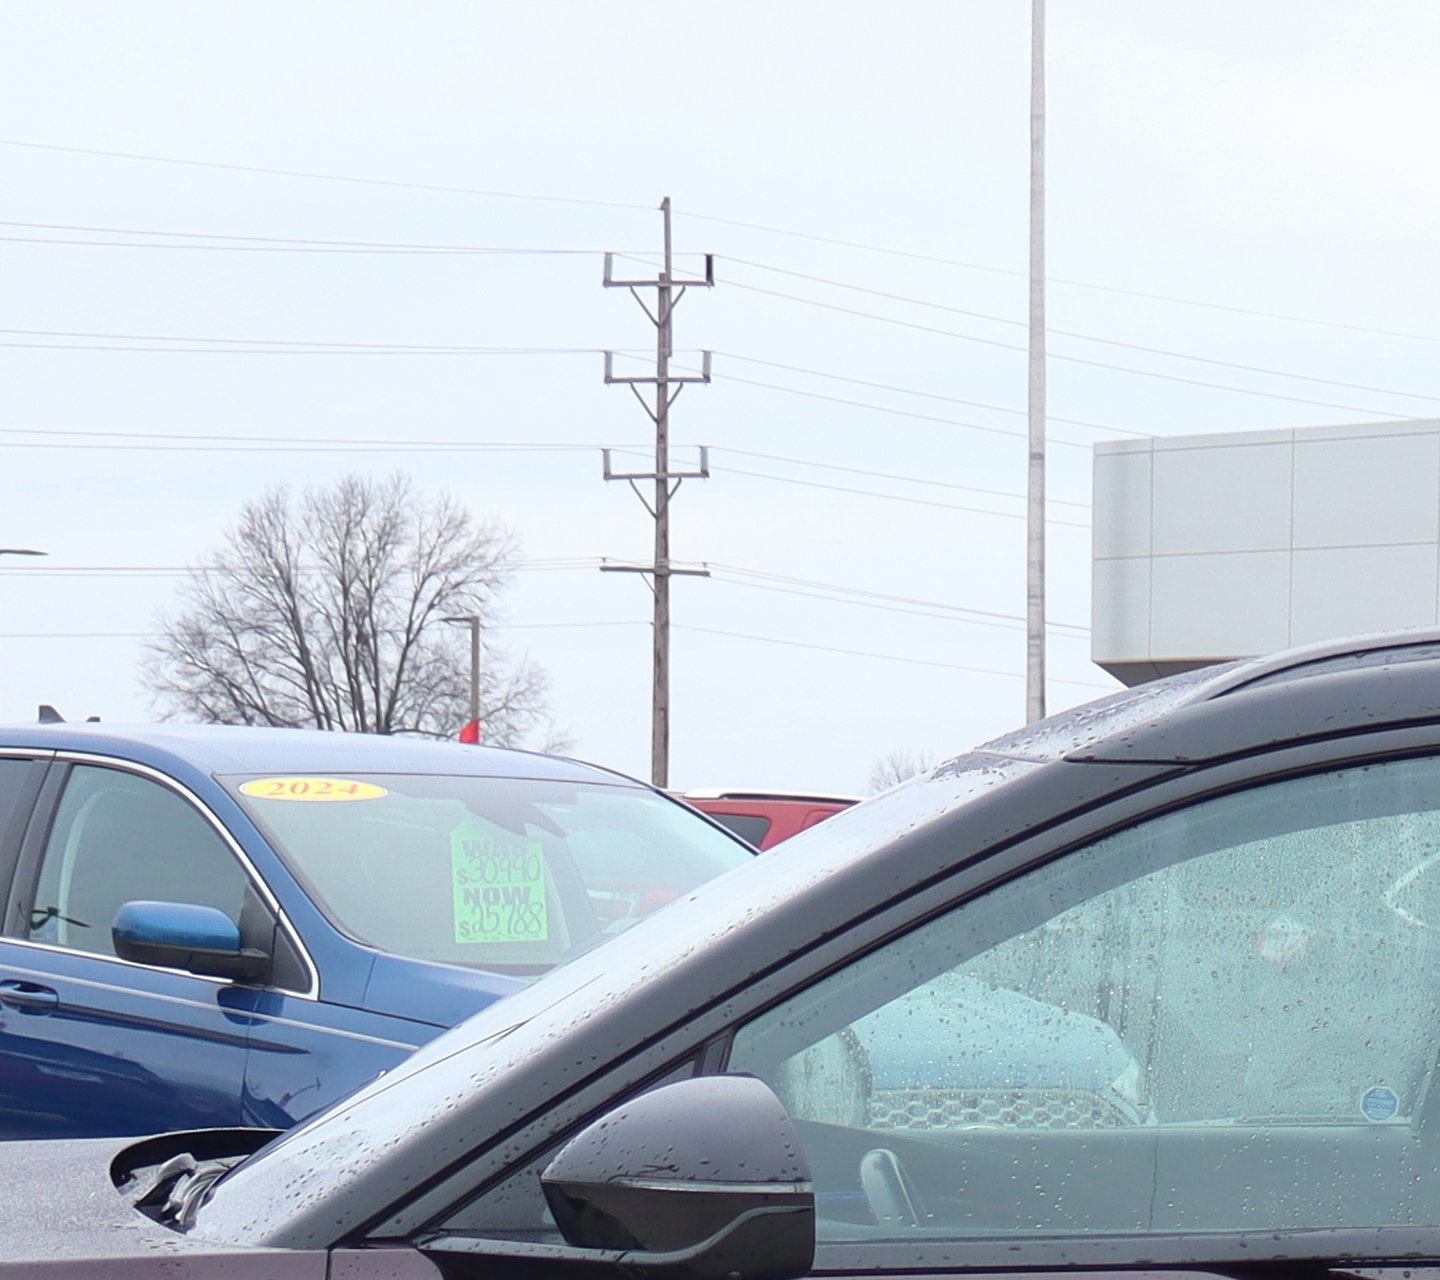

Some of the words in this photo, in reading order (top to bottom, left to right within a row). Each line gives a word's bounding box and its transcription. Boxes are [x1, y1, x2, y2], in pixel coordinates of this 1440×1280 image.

[266, 781, 359, 796] 2024
[462, 840, 529, 857] WAS
[462, 886, 532, 905] NOW
